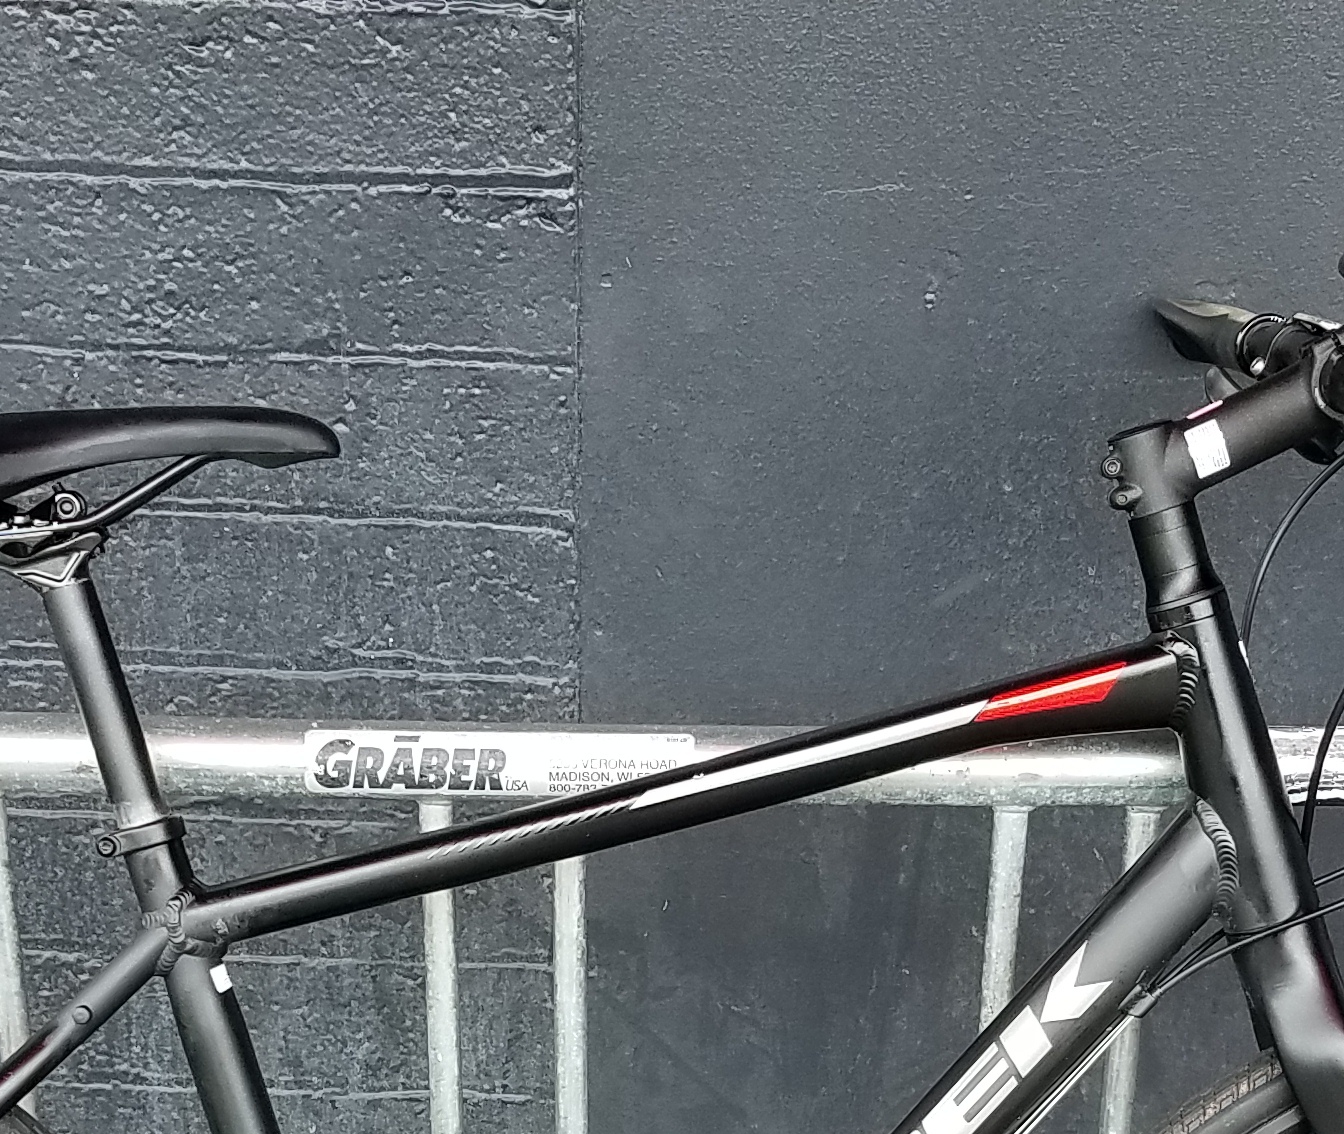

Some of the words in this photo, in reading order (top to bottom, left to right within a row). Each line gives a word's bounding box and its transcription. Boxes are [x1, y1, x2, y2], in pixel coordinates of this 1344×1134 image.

[582, 758, 636, 770] VERONA
[548, 771, 614, 783] MADISON,
[505, 778, 529, 791] USA
